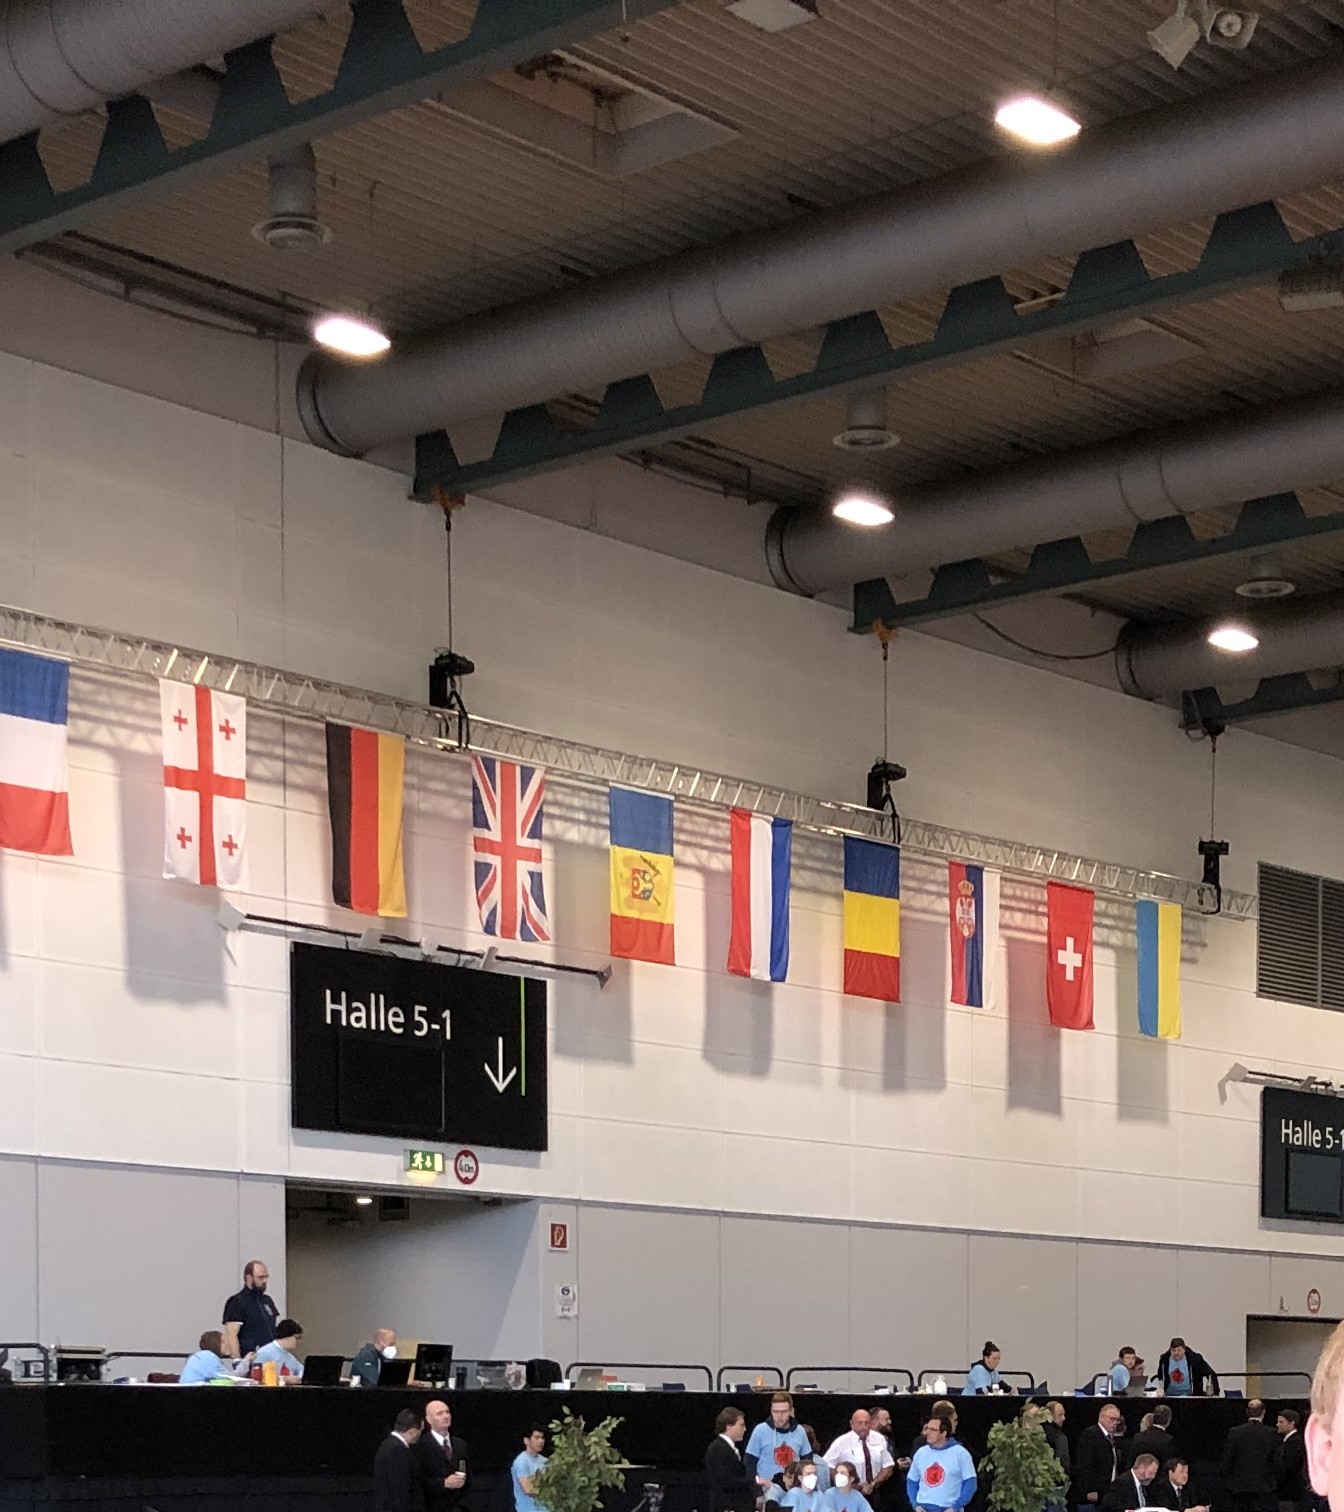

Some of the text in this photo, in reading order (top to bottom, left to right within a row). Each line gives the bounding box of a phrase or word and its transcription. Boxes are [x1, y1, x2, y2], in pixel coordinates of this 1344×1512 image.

[325, 988, 451, 1041] Halle 5-1
[1281, 1118, 1322, 1148] Halle
